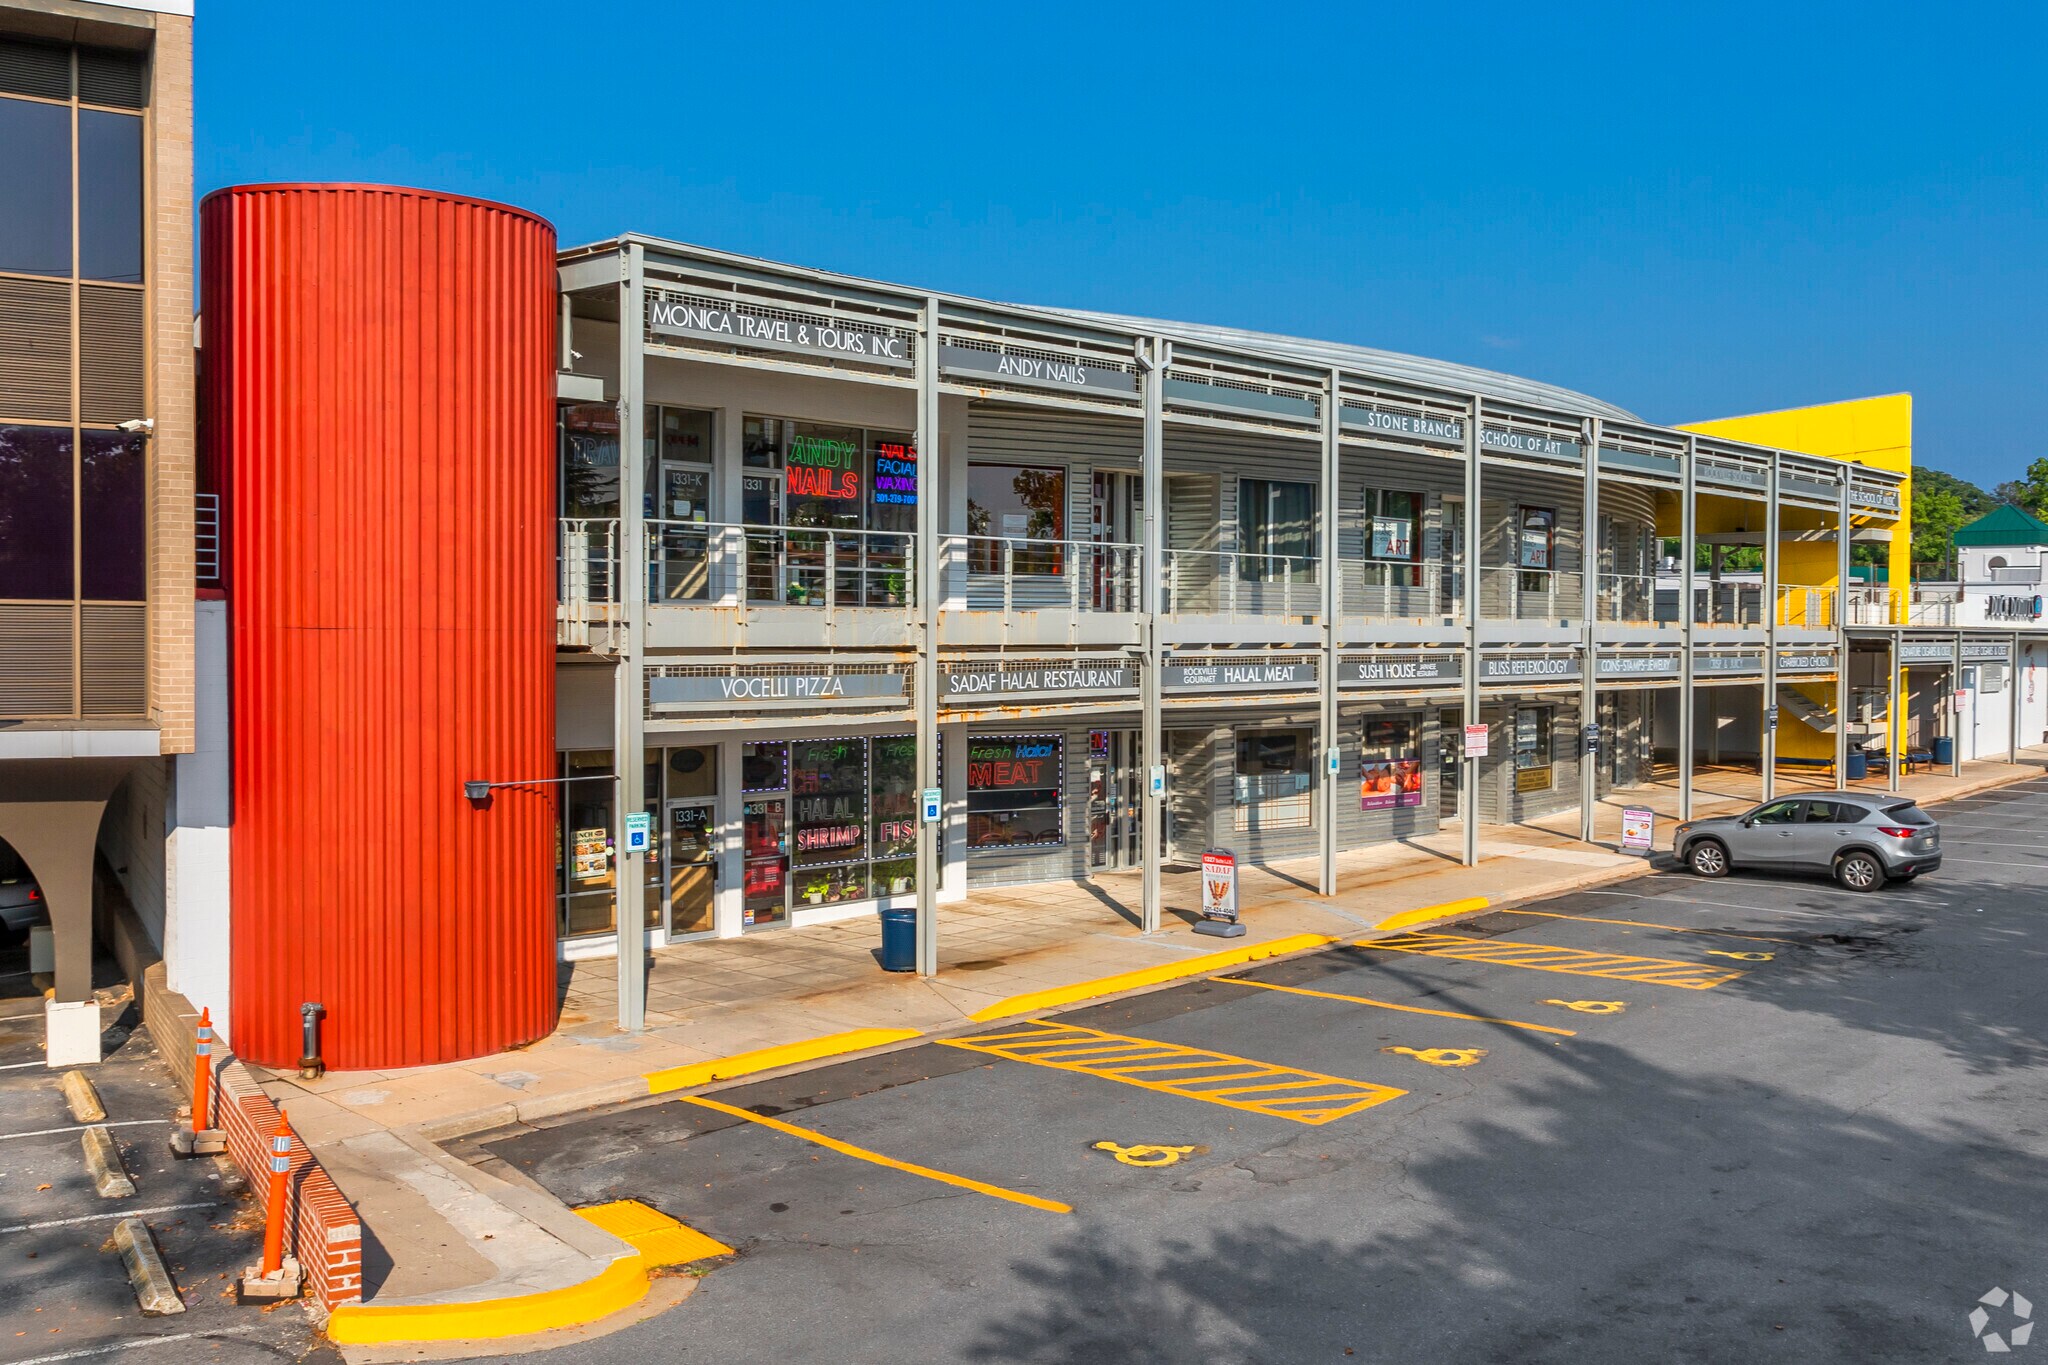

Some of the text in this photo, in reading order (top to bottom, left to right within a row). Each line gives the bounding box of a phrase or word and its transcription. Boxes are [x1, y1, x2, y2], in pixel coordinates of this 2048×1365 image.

[652, 303, 902, 359] MONICA TRAVEL & TOURS, INC.
[998, 356, 1085, 385] ANDY NAILS
[1368, 412, 1460, 439] STONE BRANCH
[1480, 430, 1561, 454] SCHOOL OF ART
[789, 436, 856, 469] ANDY
[881, 443, 917, 462] NAILS
[672, 472, 702, 487] 1331-K
[786, 466, 858, 499] NAILS
[876, 476, 918, 492] WAXING
[1385, 539, 1409, 555] ART
[1529, 549, 1545, 564] ART
[1183, 667, 1217, 676] ROCKVILLE
[1224, 666, 1295, 683] HALAL MEAT
[1359, 663, 1416, 679] SUSHI HOUSE
[1489, 660, 1568, 675] BLISS REFLEXOLOGY
[721, 677, 844, 698] VOCELLI PIZZA
[950, 670, 1123, 693] SADAF HALAL RESTAURANT
[1183, 675, 1216, 684] GOURMET
[808, 746, 847, 761] Fresh
[970, 746, 1011, 759] Fresh
[968, 761, 1043, 787] MEAT
[675, 810, 707, 822] 1331-A
[800, 797, 854, 821] HALAL
[798, 825, 860, 850] SHRIMP
[1205, 865, 1231, 875] SADAF
